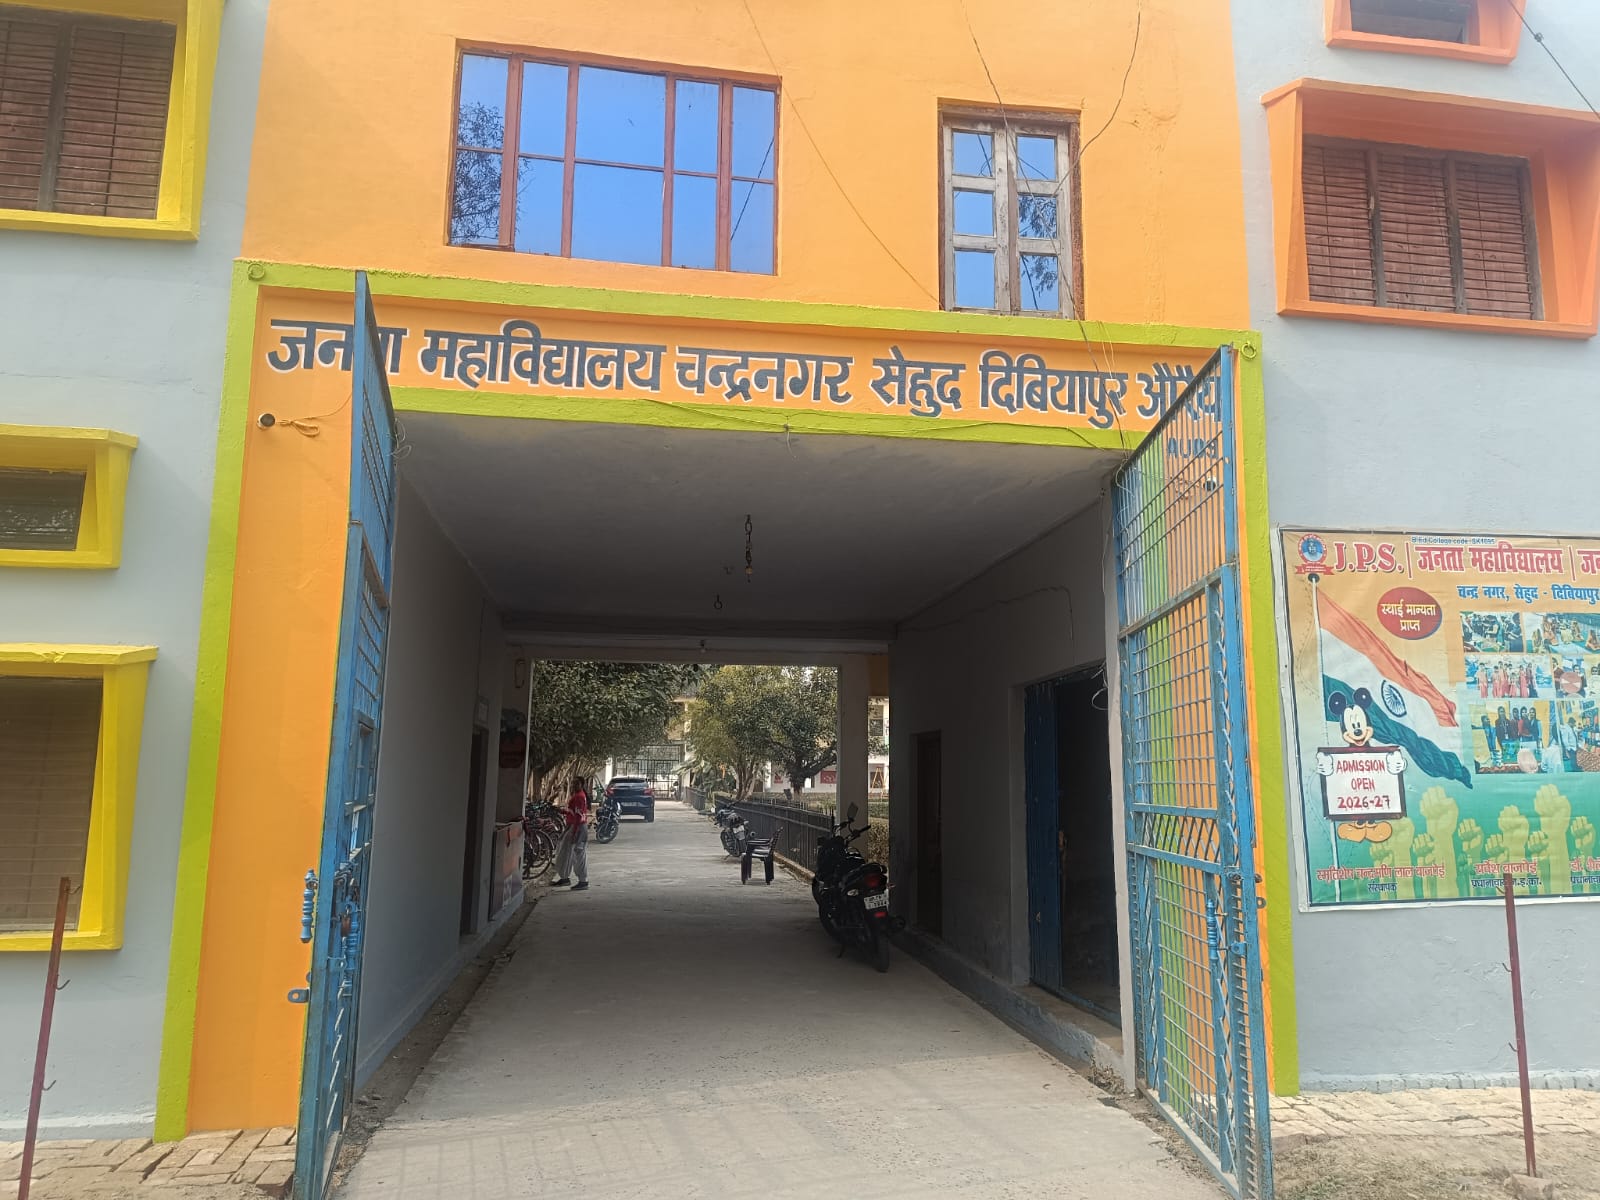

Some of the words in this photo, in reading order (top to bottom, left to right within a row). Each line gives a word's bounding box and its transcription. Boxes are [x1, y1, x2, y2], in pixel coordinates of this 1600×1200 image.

[267, 318, 407, 374] जना
[418, 319, 667, 391] महाविद्यालय
[675, 345, 854, 404] चन्द्रनगर
[869, 345, 966, 418] सेहुद
[979, 349, 1129, 429] दिबियापुर
[1334, 542, 1404, 573] J.P.S.
[1414, 546, 1464, 571] जनता
[1468, 541, 1563, 573] महाविद्यालय
[1405, 604, 1436, 616] मान्यता
[1400, 620, 1420, 632] प्राप्त
[1336, 759, 1386, 774] ADMISSION
[1351, 777, 1375, 791] OPEN
[1337, 794, 1391, 809] 2026-27
